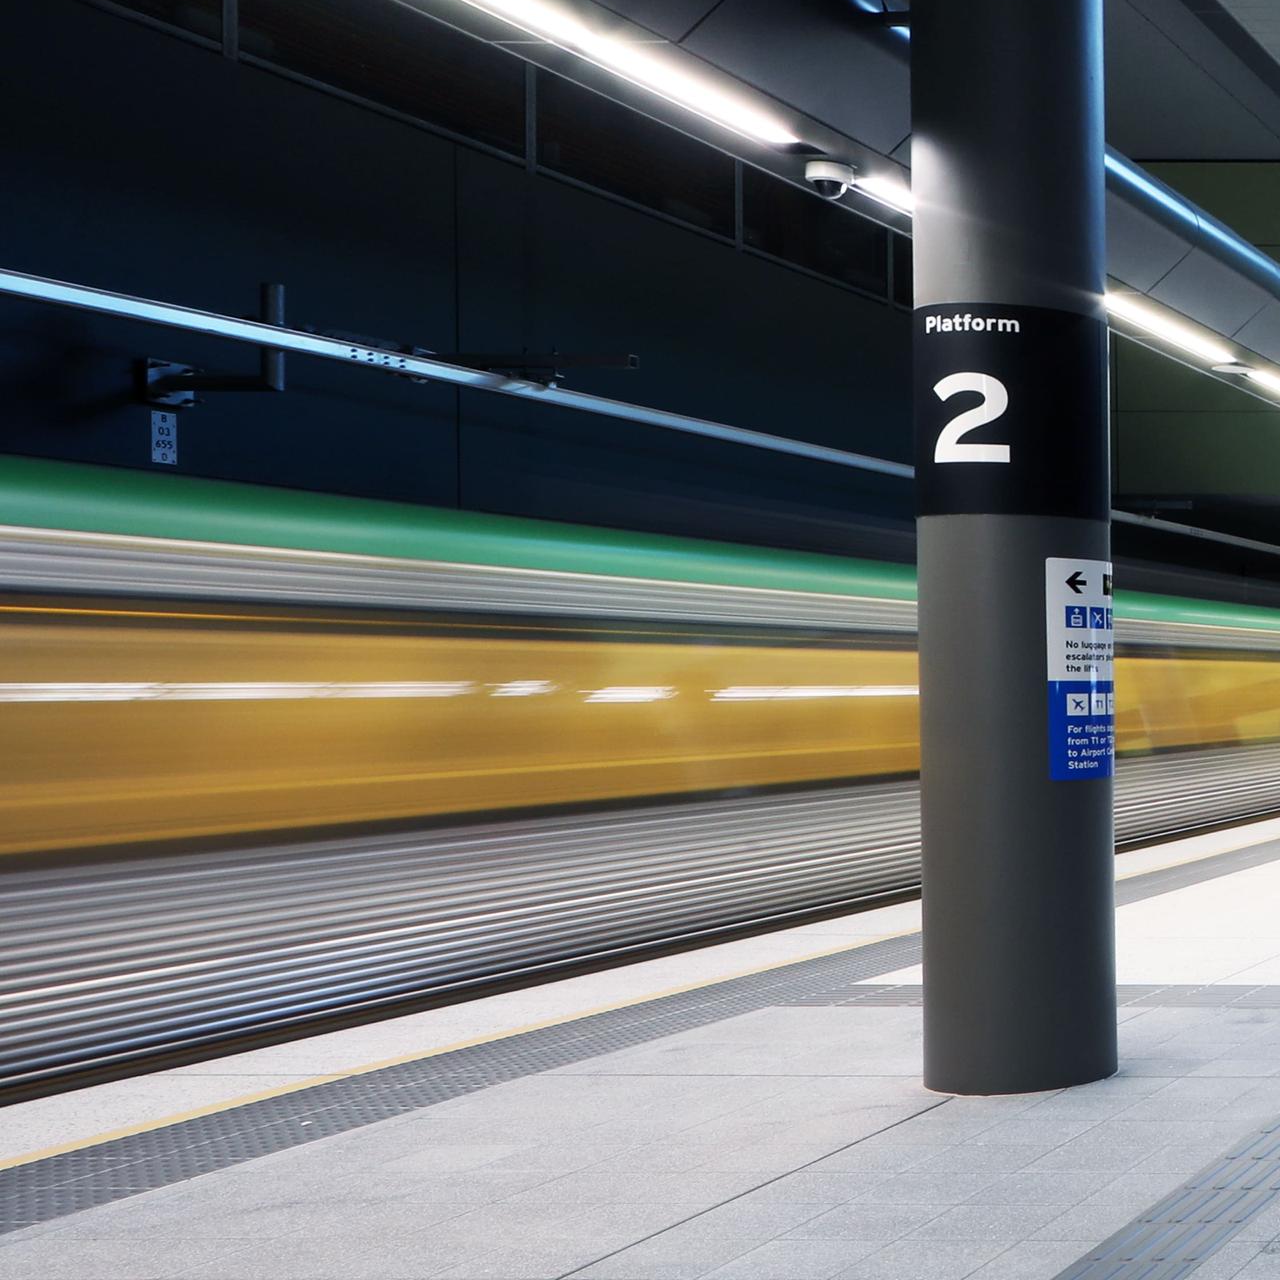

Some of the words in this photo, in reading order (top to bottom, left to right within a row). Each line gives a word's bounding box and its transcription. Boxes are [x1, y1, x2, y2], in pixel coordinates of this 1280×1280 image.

[925, 313, 1020, 334] Platform
[933, 372, 1010, 463] 2
[155, 440, 173, 449] 655
[1065, 640, 1079, 649] No
[1081, 640, 1107, 651] luggage
[1065, 652, 1105, 661] escalators
[1065, 664, 1081, 673] the
[1095, 699, 1104, 709] T1
[1067, 725, 1083, 734] For
[1084, 724, 1106, 735] flights
[1067, 737, 1089, 746] from
[1091, 736, 1099, 745] T1
[1067, 749, 1078, 758] to
[1080, 748, 1105, 759] Airport
[1067, 760, 1099, 770] Station
